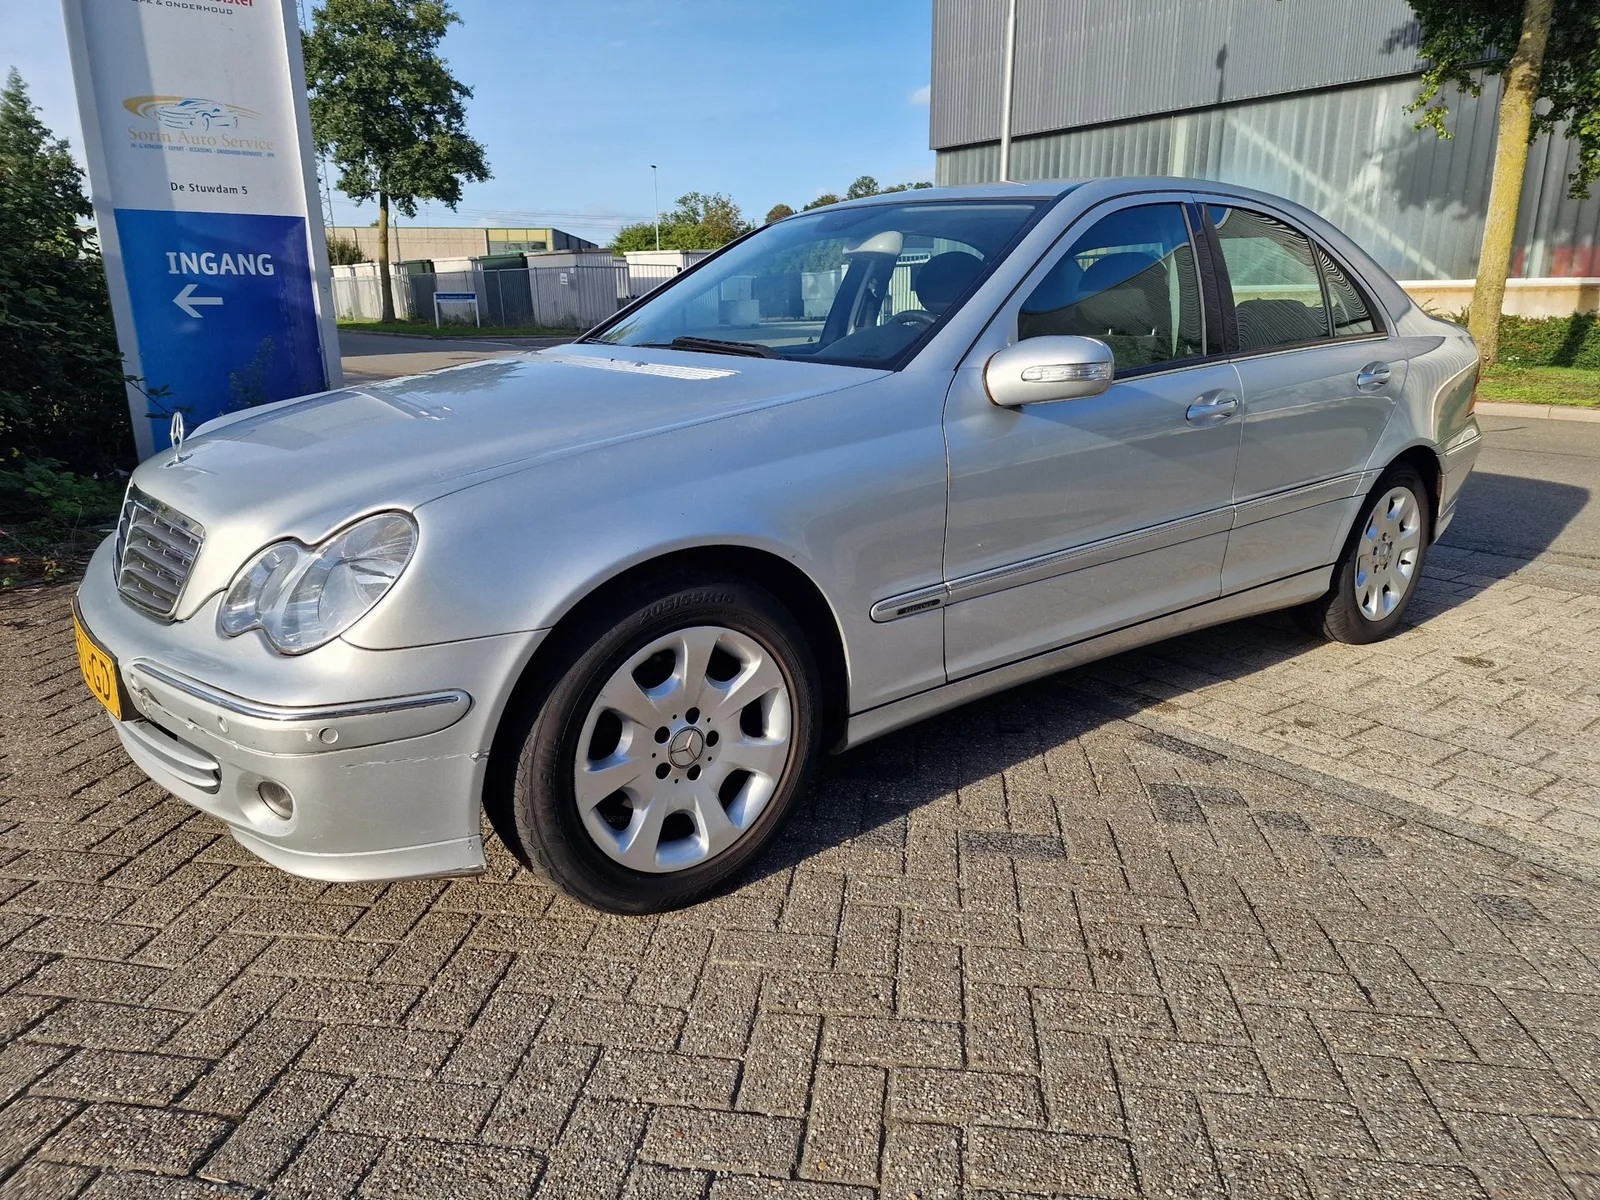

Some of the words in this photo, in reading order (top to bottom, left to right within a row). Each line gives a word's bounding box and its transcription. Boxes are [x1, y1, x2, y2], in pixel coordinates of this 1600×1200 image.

[165, 1, 234, 15] ONDERHOUD
[127, 126, 172, 143] Sorin
[178, 131, 217, 146] Auto
[221, 133, 274, 150] Service
[170, 182, 185, 191] De
[188, 183, 238, 194] Stuwdam
[241, 186, 248, 195] 5
[165, 252, 275, 276] INGANG
